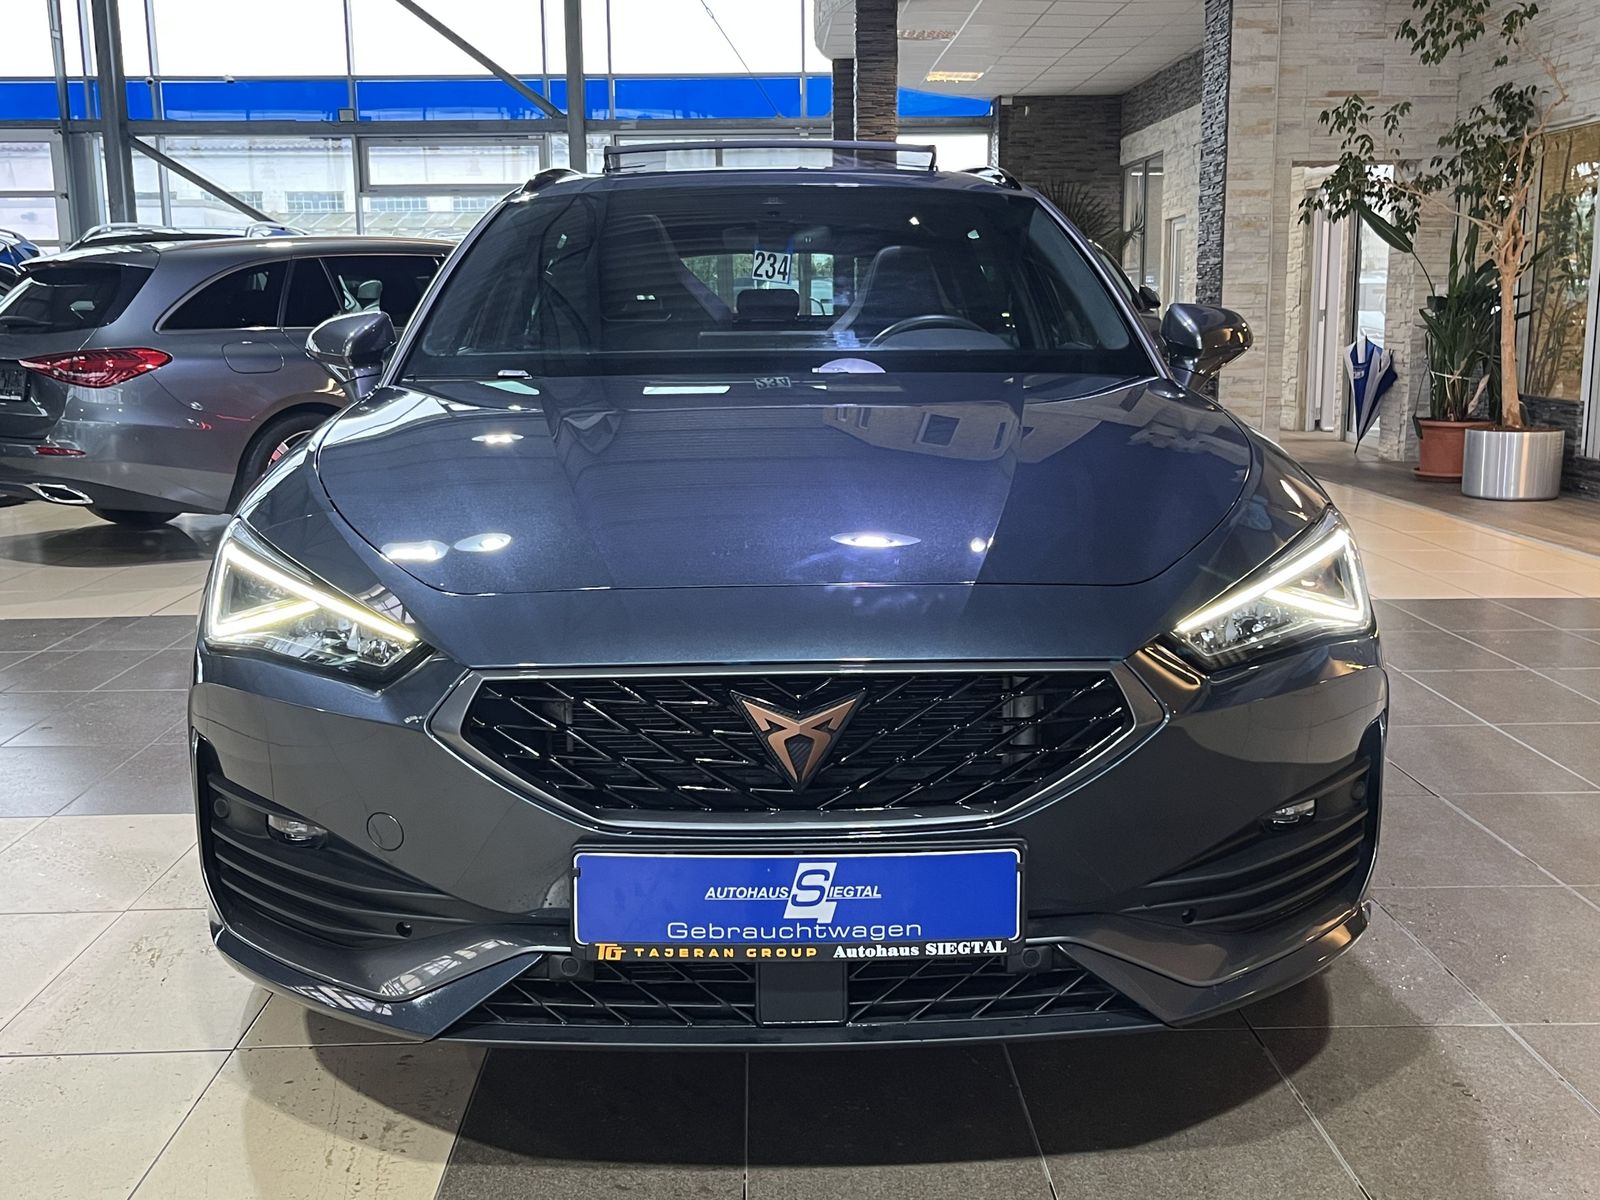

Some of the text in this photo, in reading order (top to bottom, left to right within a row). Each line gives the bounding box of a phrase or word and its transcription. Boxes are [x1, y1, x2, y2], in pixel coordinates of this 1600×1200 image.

[753, 251, 789, 281] 234
[705, 869, 881, 907] AUTOHAUS SIEGTAL
[667, 922, 922, 941] Gebrauchtwagen
[634, 948, 735, 958] TAJERAN
[746, 948, 818, 958] GROUP
[833, 941, 1007, 959] Autohaus SIEGTAL
